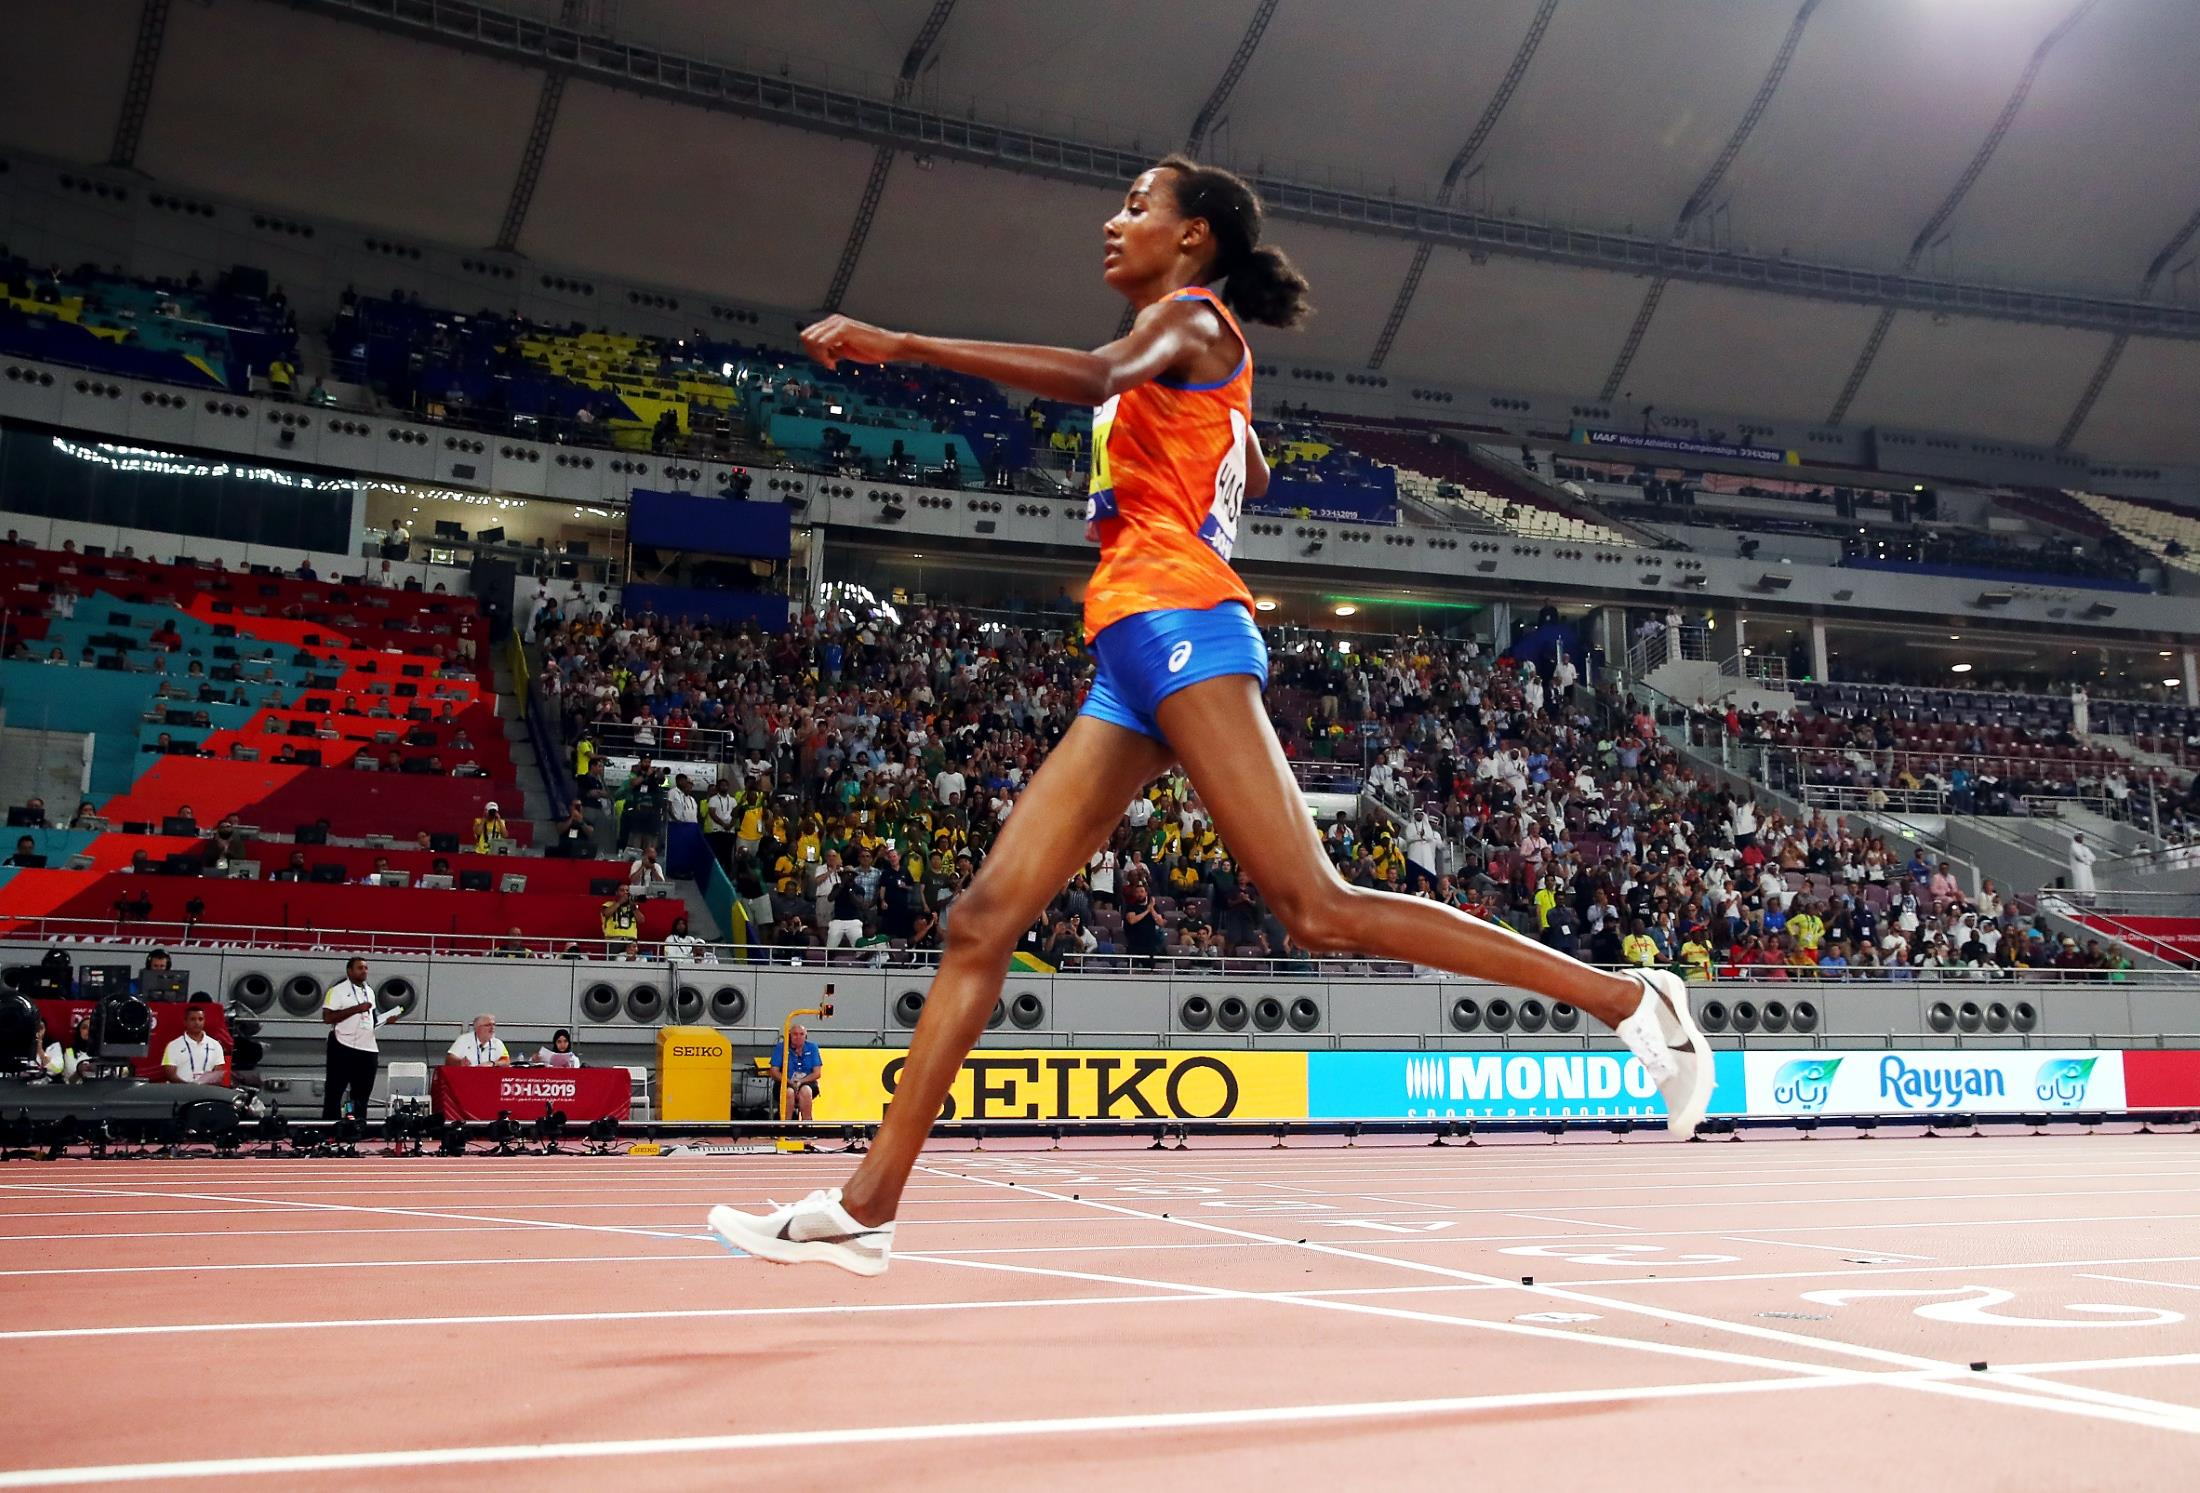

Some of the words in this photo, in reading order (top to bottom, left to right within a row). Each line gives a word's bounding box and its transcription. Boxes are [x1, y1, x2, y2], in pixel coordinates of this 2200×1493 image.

[1593, 432, 1618, 442] IAAF
[1619, 435, 1644, 446] World
[1644, 438, 1678, 449] Athletics
[1219, 463, 1242, 523] HAS
[673, 1046, 723, 1057] SEIKO
[1449, 1056, 1658, 1100] MONDO
[1880, 1055, 2005, 1108] Rayyan
[500, 1083, 576, 1097] DOHA2019
[1298, 1218, 1459, 1233] 4
[1497, 1244, 1742, 1266] 3
[1799, 1285, 2186, 1328] 2
